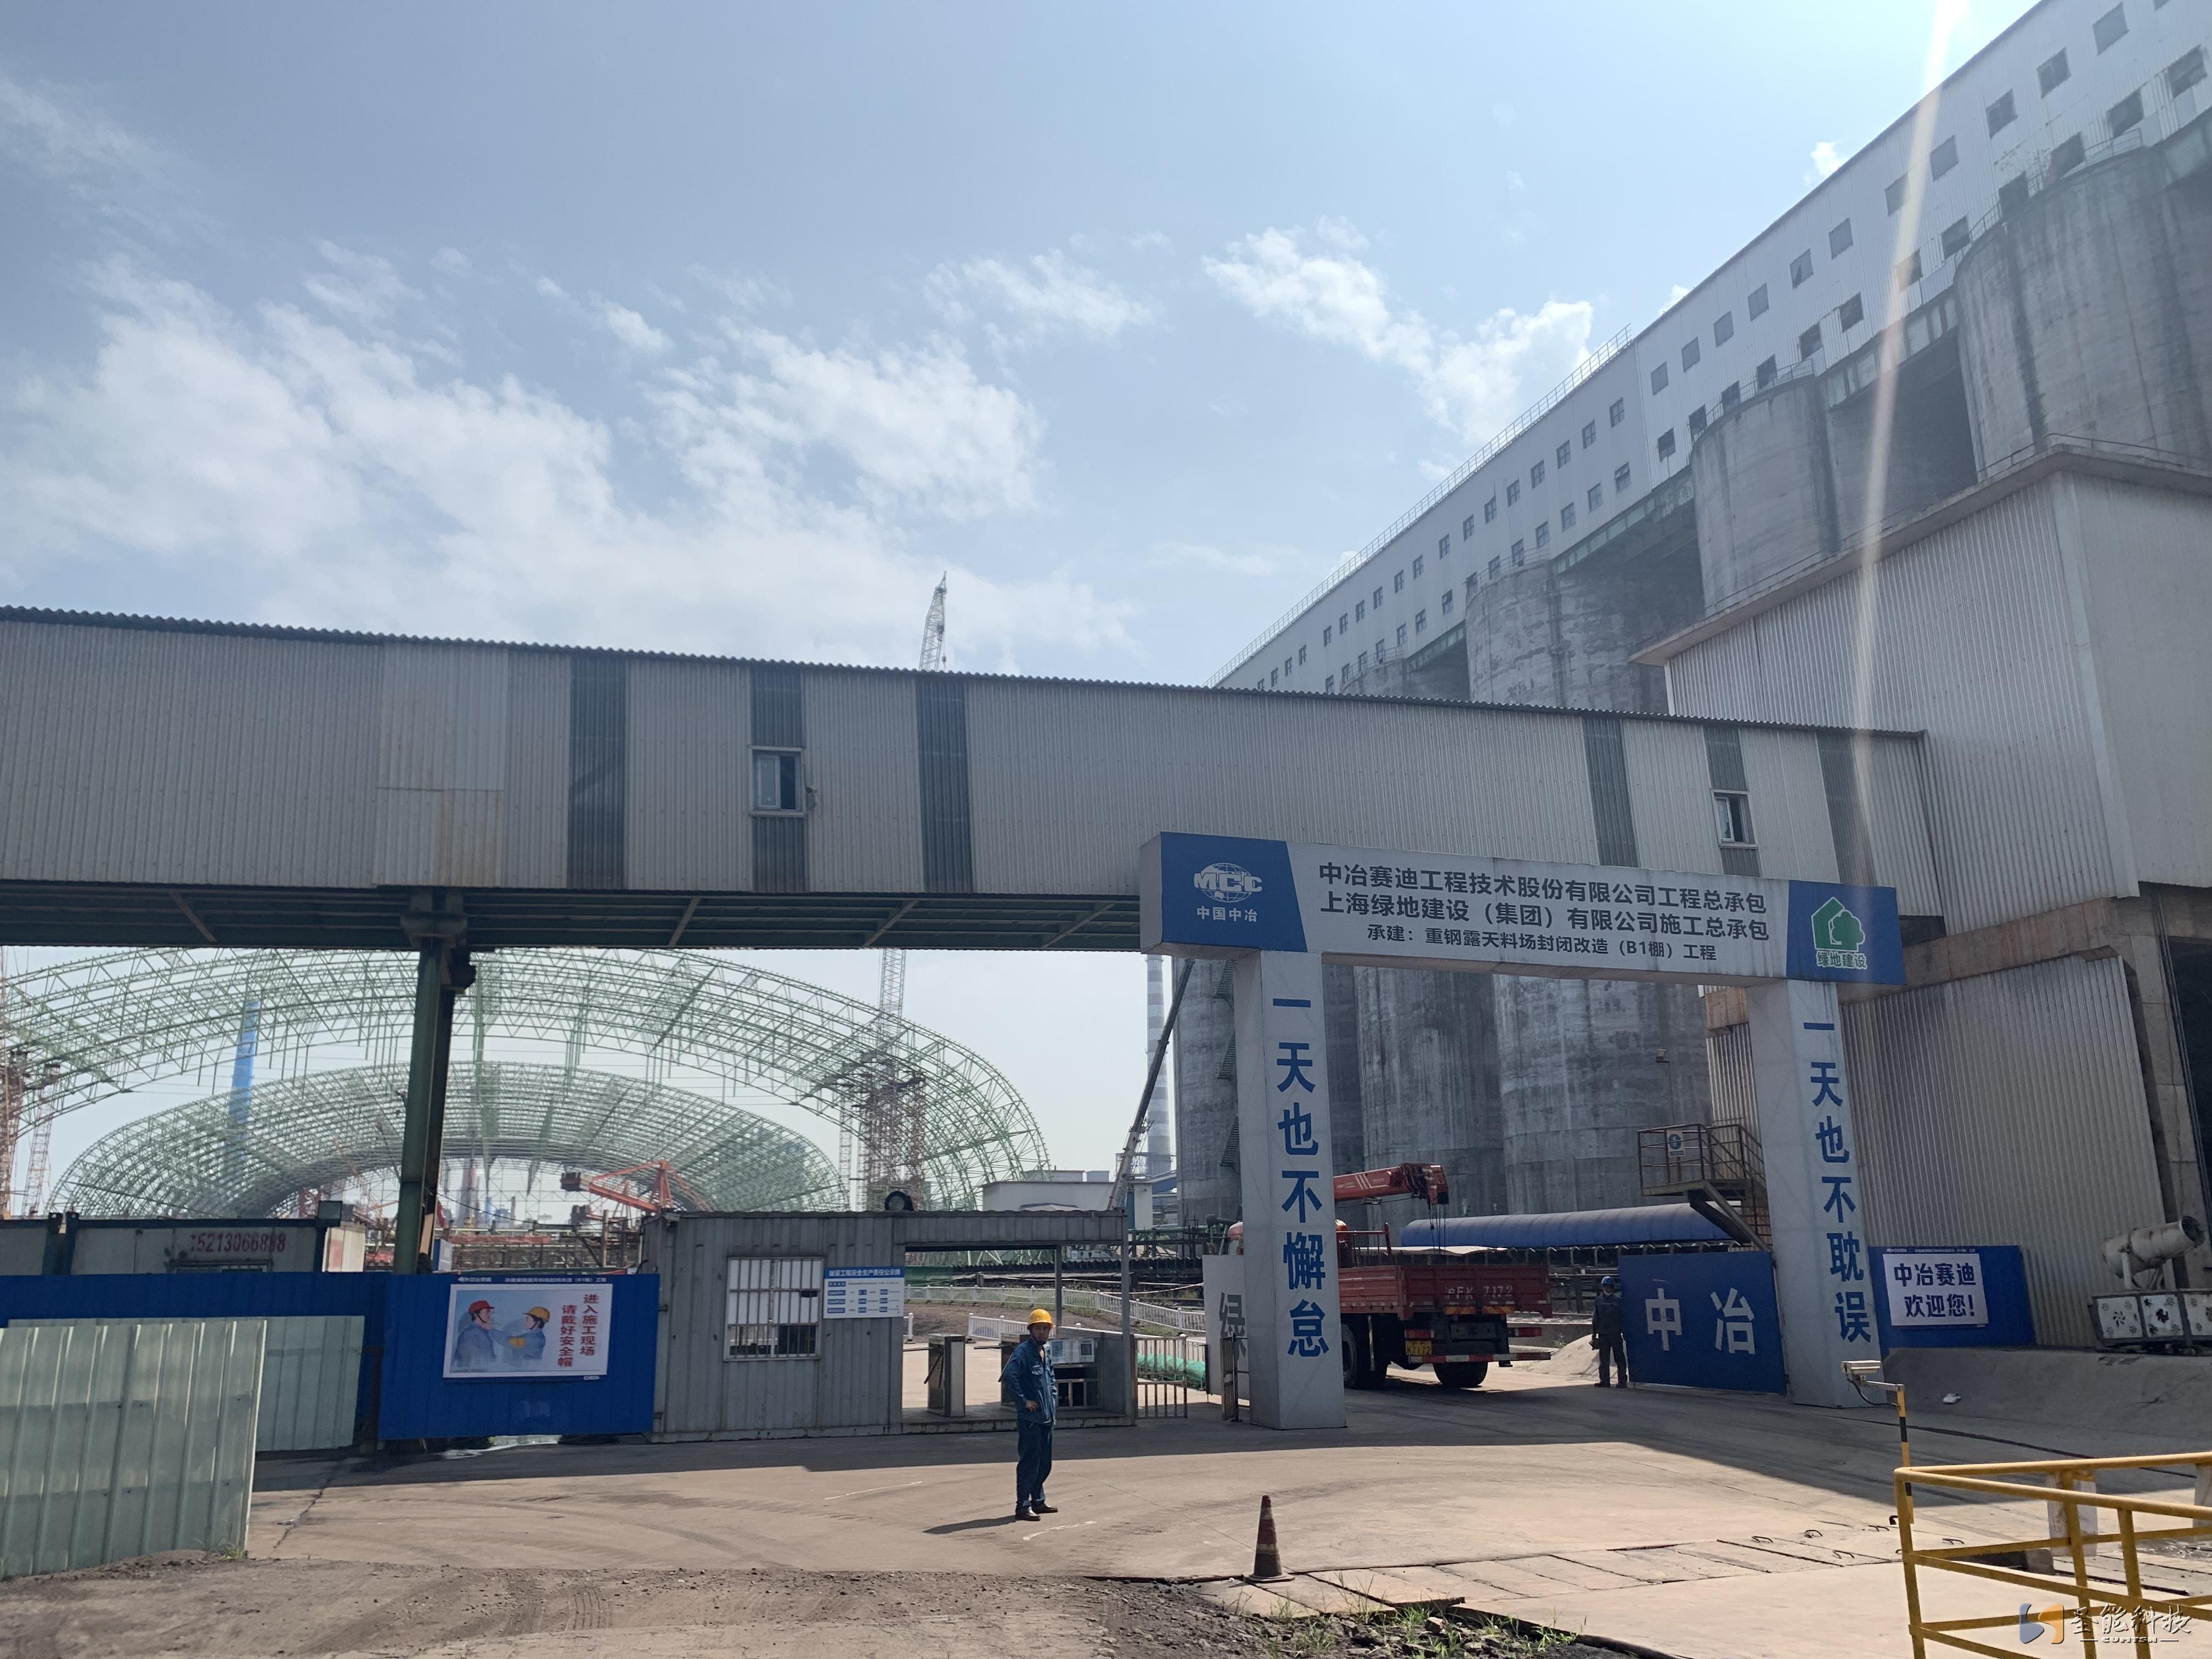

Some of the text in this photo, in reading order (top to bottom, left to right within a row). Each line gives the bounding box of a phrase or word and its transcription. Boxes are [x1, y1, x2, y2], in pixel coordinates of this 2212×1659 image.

[1194, 872, 1262, 893] MCC
[1319, 861, 1767, 914] 中冶赛迪工程技术股份有限公司工程总承包
[1197, 905, 1258, 923] 中国中冶
[1320, 890, 1770, 941] 上海绿地建设（集团）有限公司施工总承包
[1816, 950, 1867, 969] 绿地建设
[1272, 997, 1329, 1358] 一天也不懈怠
[1803, 1022, 1872, 1344] 一天也不耽误
[1893, 1262, 1977, 1287] 中冶赛迪
[557, 1305, 578, 1367] 请戴好安全帽
[579, 1294, 599, 1356] 进入施工现场
[1645, 1286, 1756, 1355] 中冶
